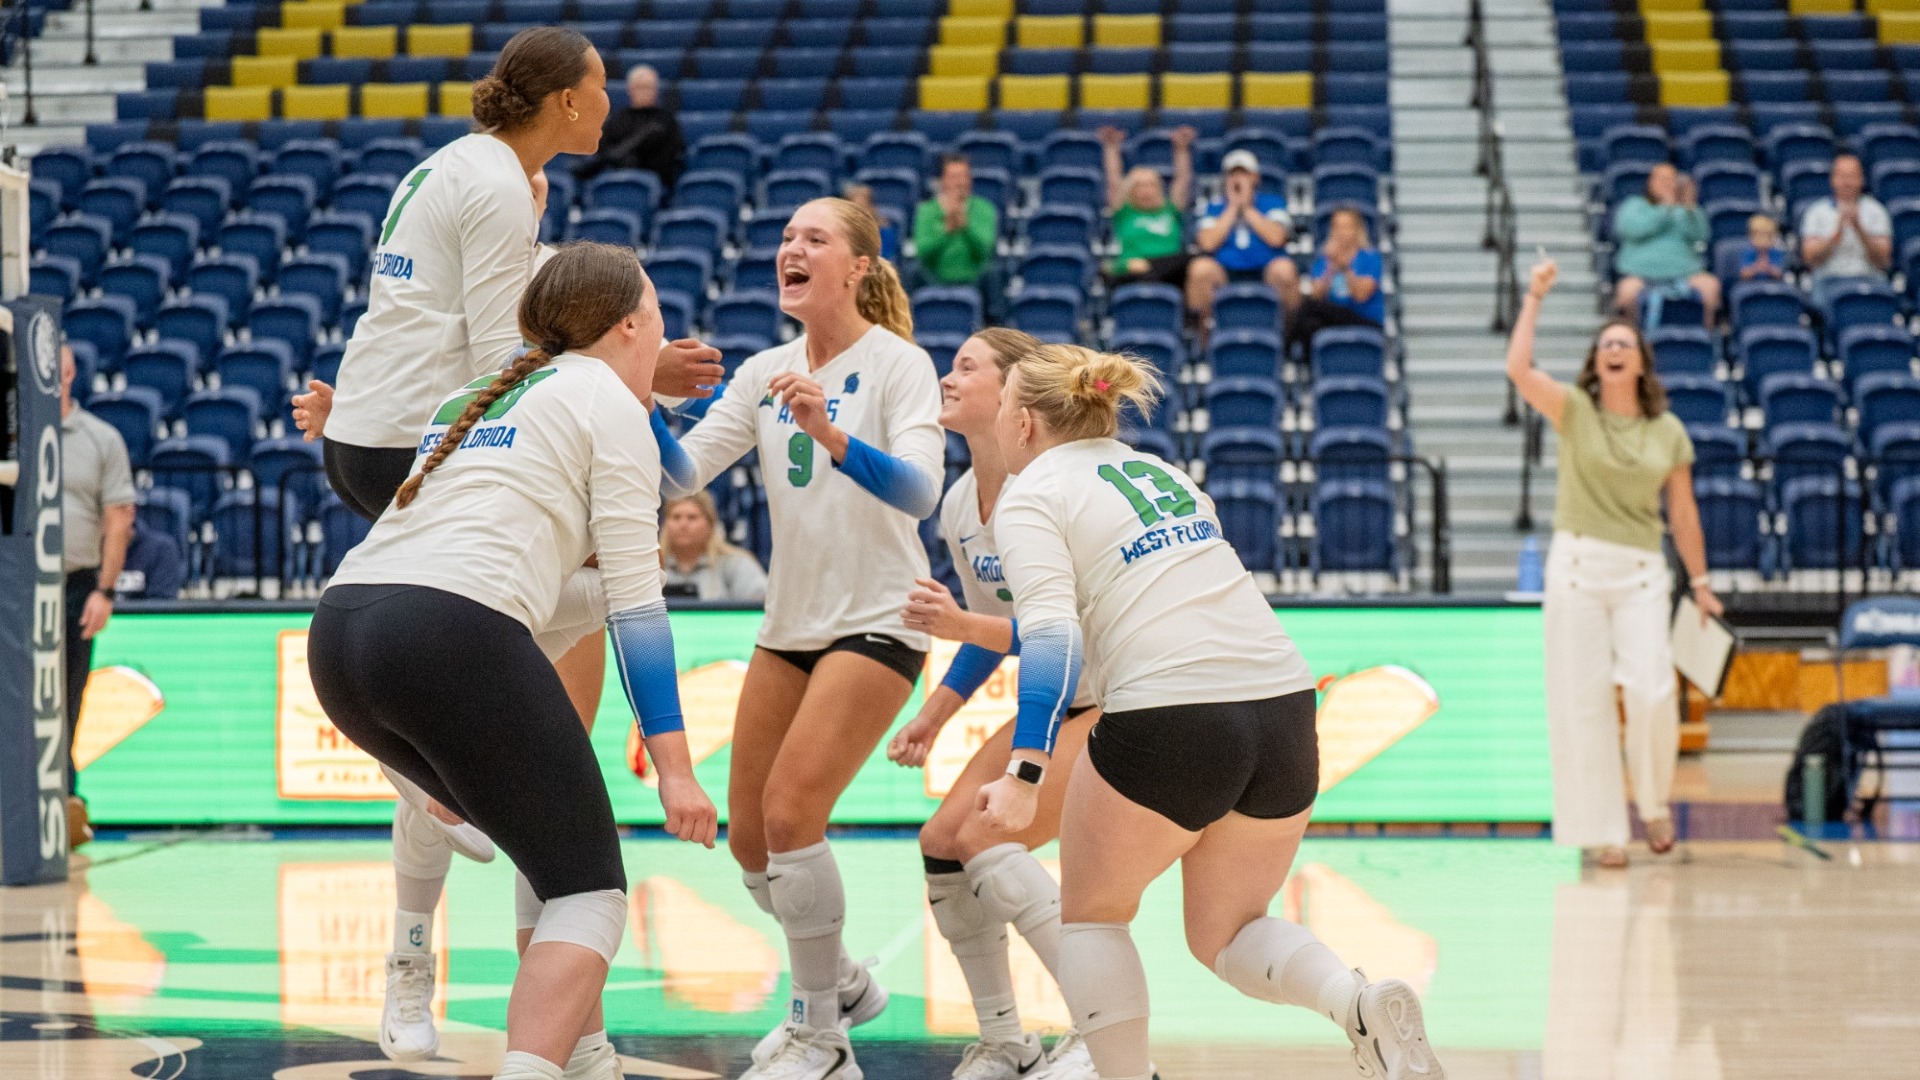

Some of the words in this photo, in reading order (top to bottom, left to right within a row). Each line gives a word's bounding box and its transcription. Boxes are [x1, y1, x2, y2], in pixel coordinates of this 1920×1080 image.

[458, 426, 517, 450] LORIDA
[788, 432, 814, 487] 9
[1097, 460, 1197, 528] 13
[973, 555, 1006, 583] ARG
[1120, 528, 1172, 565] WEST
[33, 424, 65, 861] QUEENS
